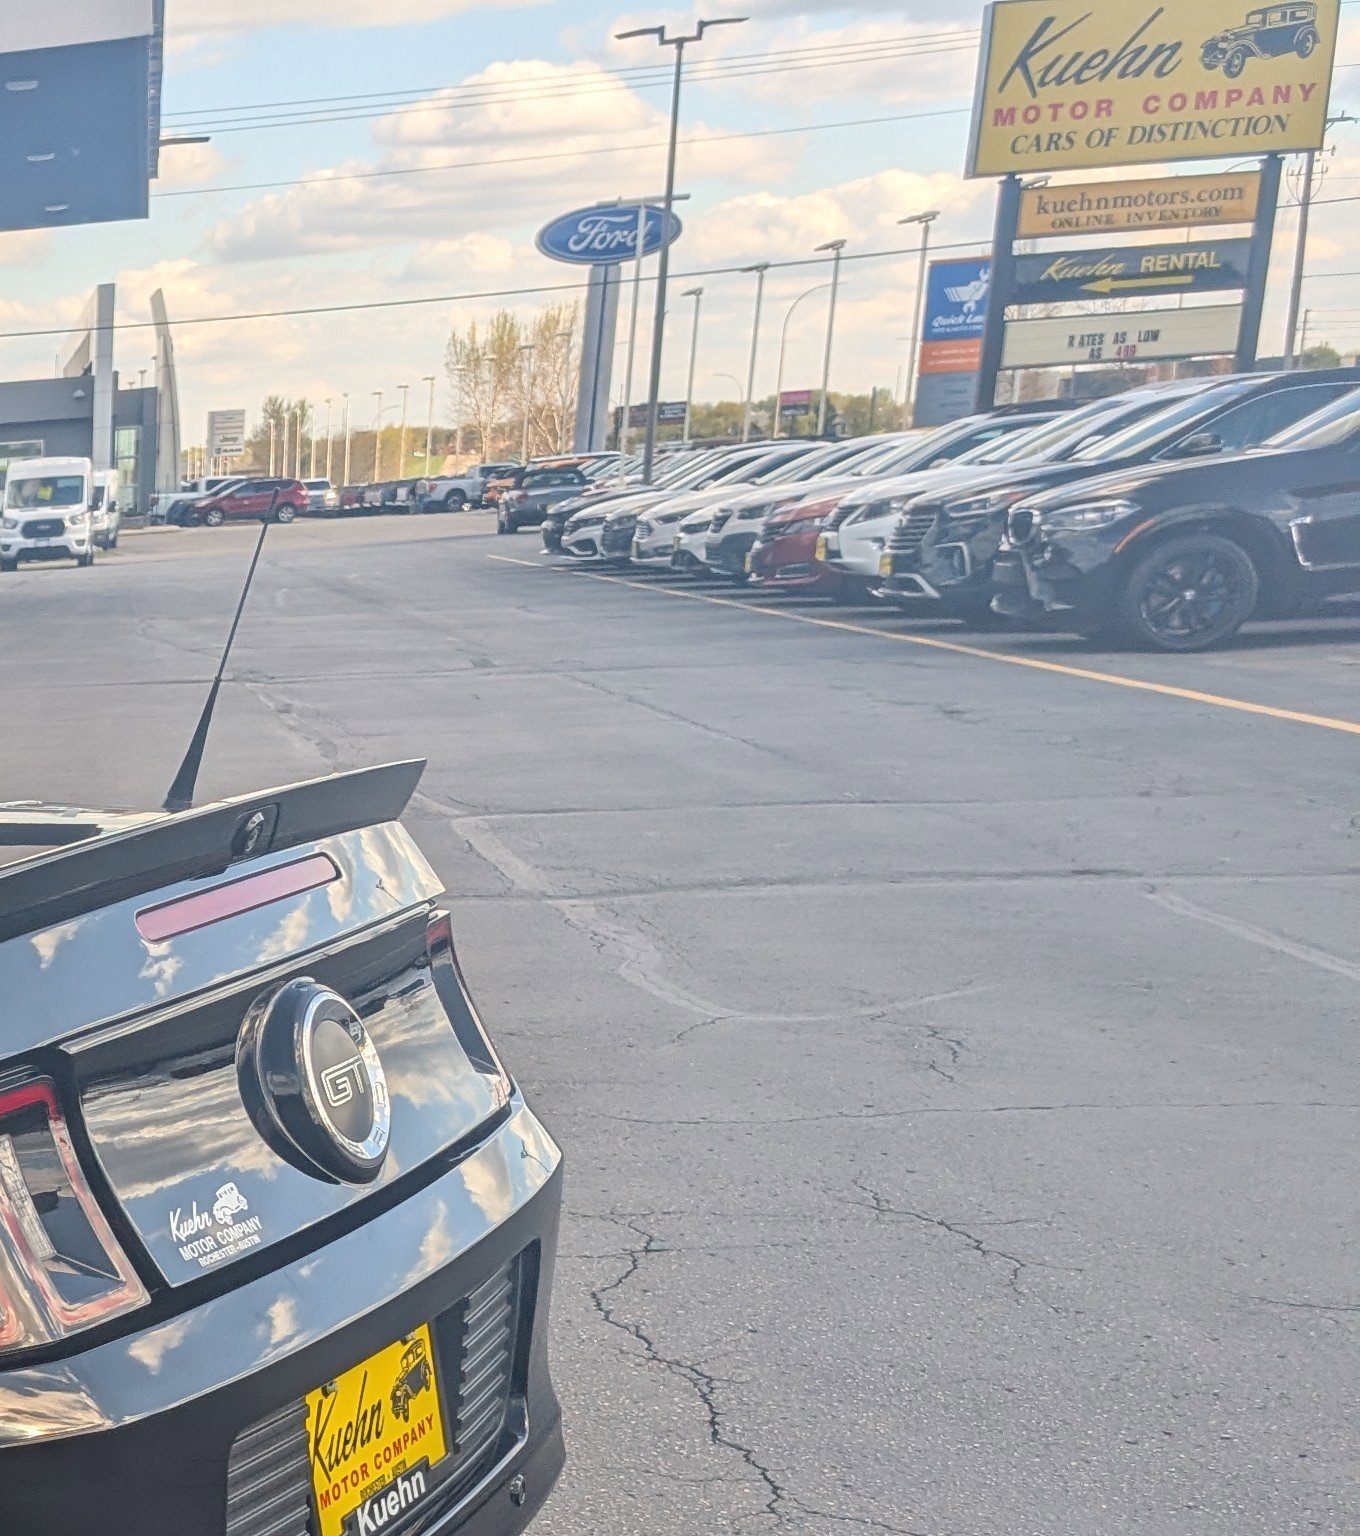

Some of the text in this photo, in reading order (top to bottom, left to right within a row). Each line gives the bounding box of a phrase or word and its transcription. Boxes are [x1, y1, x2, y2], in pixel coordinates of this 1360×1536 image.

[998, 7, 1183, 98] Kuehn
[992, 82, 1317, 127] MOTOR COMPANY
[1010, 114, 1292, 154] CARS OF DISTINCTION
[1035, 185, 1244, 214] kuehnmotors.com
[1051, 206, 1222, 229] ONLINE INVENTORY
[1039, 251, 1221, 282] Kuehn RENTAL
[1088, 347, 1102, 360] AS
[1112, 331, 1127, 345] AS
[1138, 329, 1160, 343] LOW
[320, 1054, 364, 1107] GT
[169, 1200, 212, 1242] Kuehn
[178, 1215, 262, 1261] MOTOR COMPANY
[311, 1369, 385, 1484] Kuehn
[319, 1412, 434, 1510] MOTOR COMPANY
